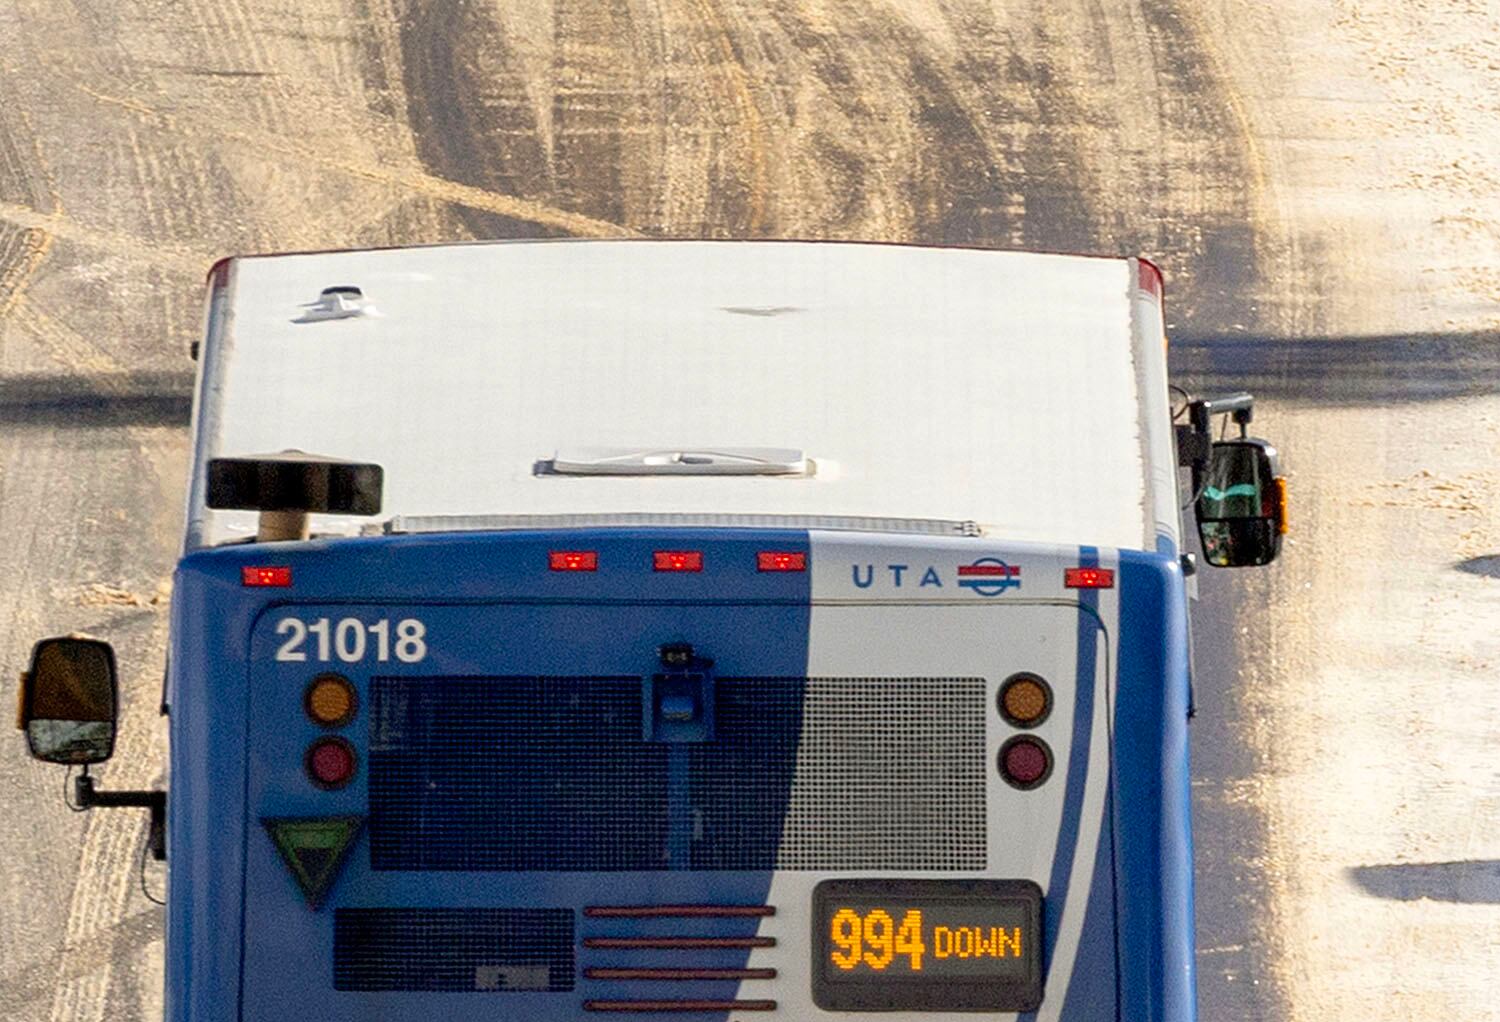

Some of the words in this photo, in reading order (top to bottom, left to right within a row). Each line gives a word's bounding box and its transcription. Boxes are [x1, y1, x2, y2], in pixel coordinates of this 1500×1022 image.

[851, 564, 943, 588] UTA
[275, 617, 427, 663] 21018
[831, 907, 925, 970] 994
[933, 926, 1022, 958] DOWN
